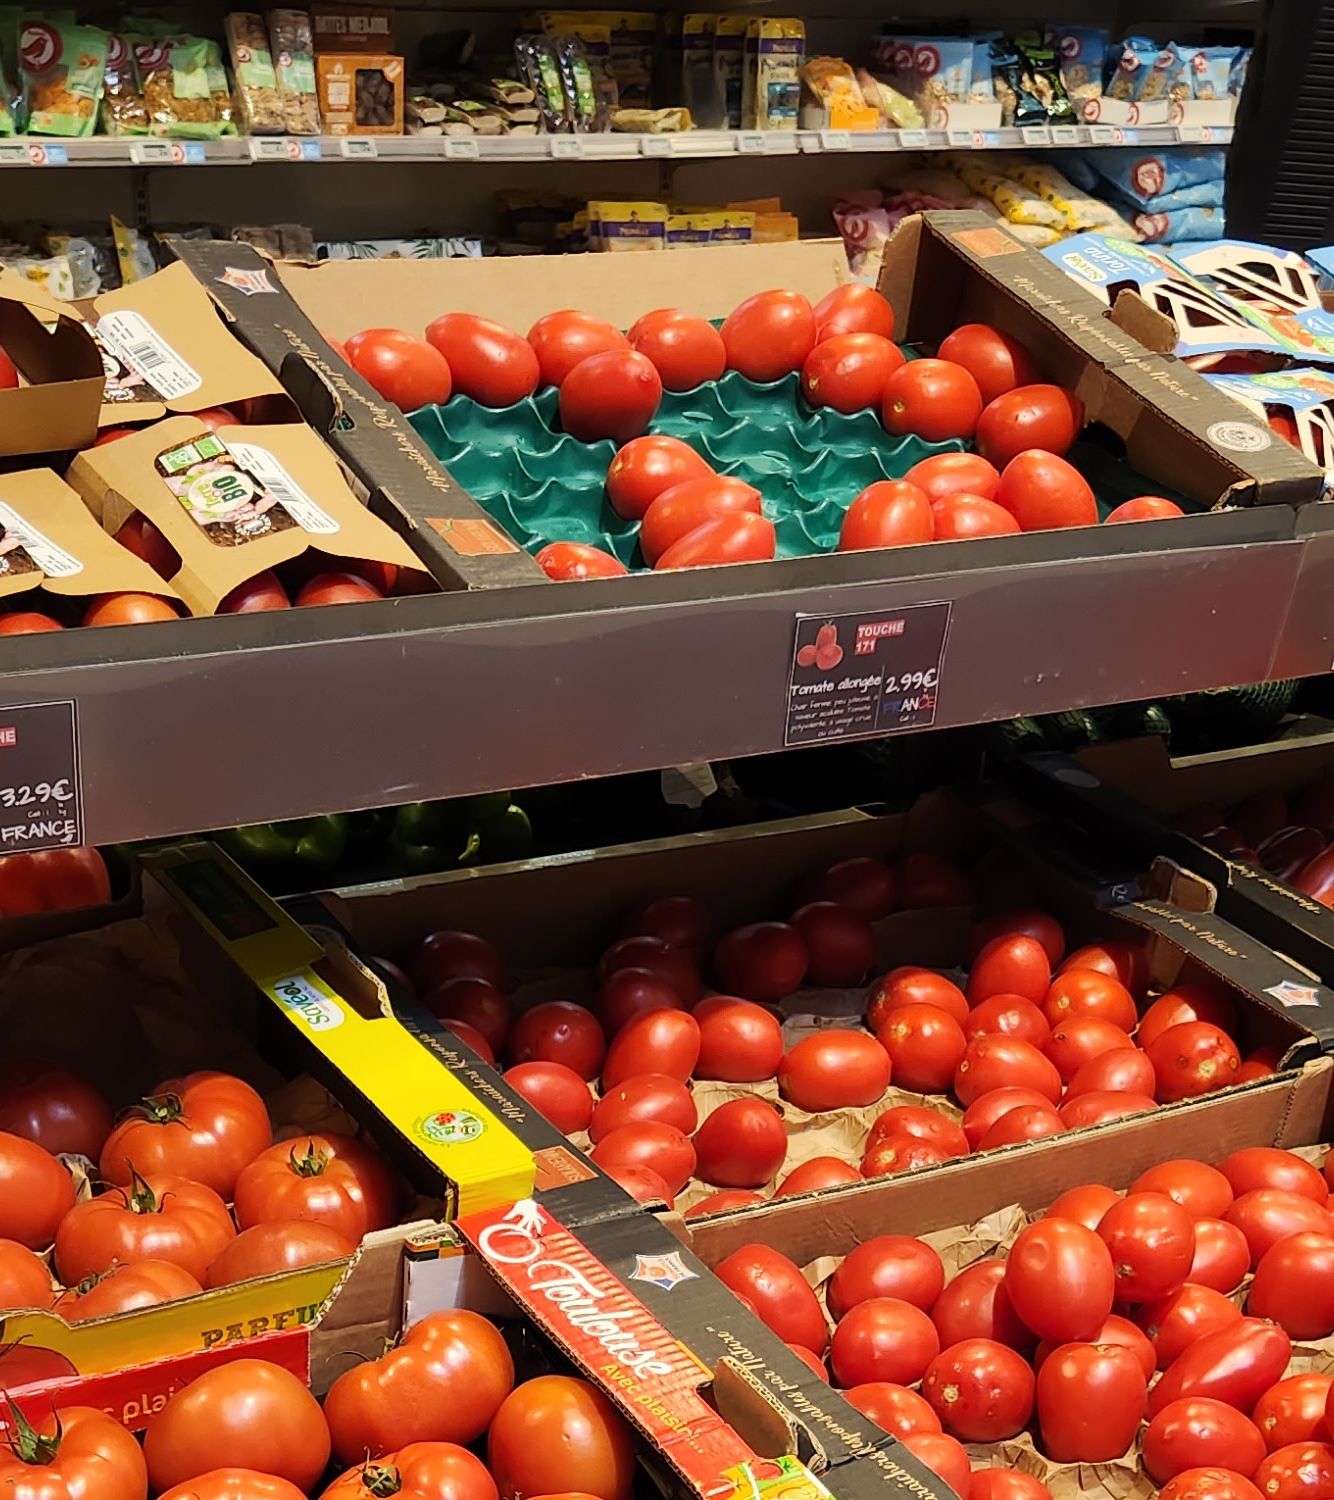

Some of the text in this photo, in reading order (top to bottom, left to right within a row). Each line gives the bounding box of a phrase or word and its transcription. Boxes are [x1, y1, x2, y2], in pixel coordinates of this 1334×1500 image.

[1084, 246, 1132, 275] Torino
[211, 475, 248, 503] BIO
[858, 623, 904, 637] TOUCHE
[856, 640, 875, 652] 171
[791, 675, 882, 697] Tomate allongée
[885, 668, 938, 694] 2.99€
[791, 703, 808, 712] Chair
[883, 696, 935, 714] FRANCE
[0, 779, 74, 808] 3.29€
[1, 820, 77, 843] FRANCE
[277, 980, 331, 1026] Savéol
[528, 1260, 673, 1379] Toulouse
[600, 1364, 641, 1395] Avec
